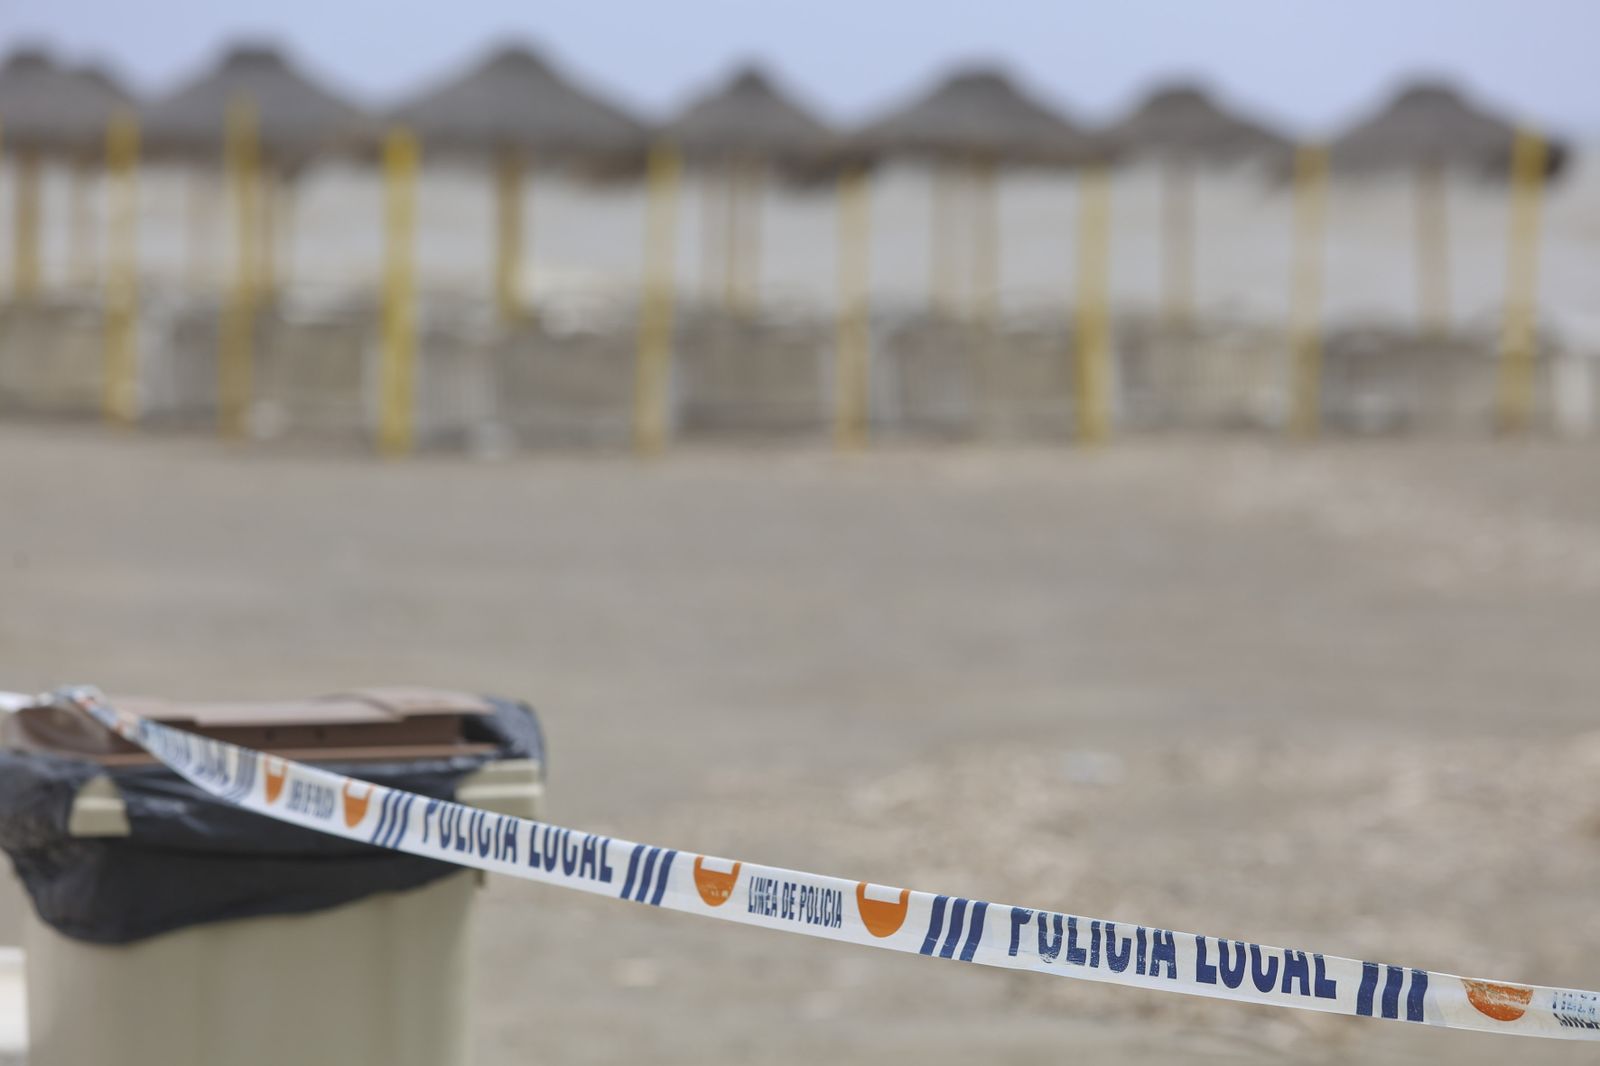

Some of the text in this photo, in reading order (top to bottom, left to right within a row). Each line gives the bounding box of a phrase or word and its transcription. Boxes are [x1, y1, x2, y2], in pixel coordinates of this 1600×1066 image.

[528, 824, 613, 883] LOCAL
[747, 875, 842, 928] LINEA DE POLICIA
[1196, 935, 1337, 999] LOCAL
